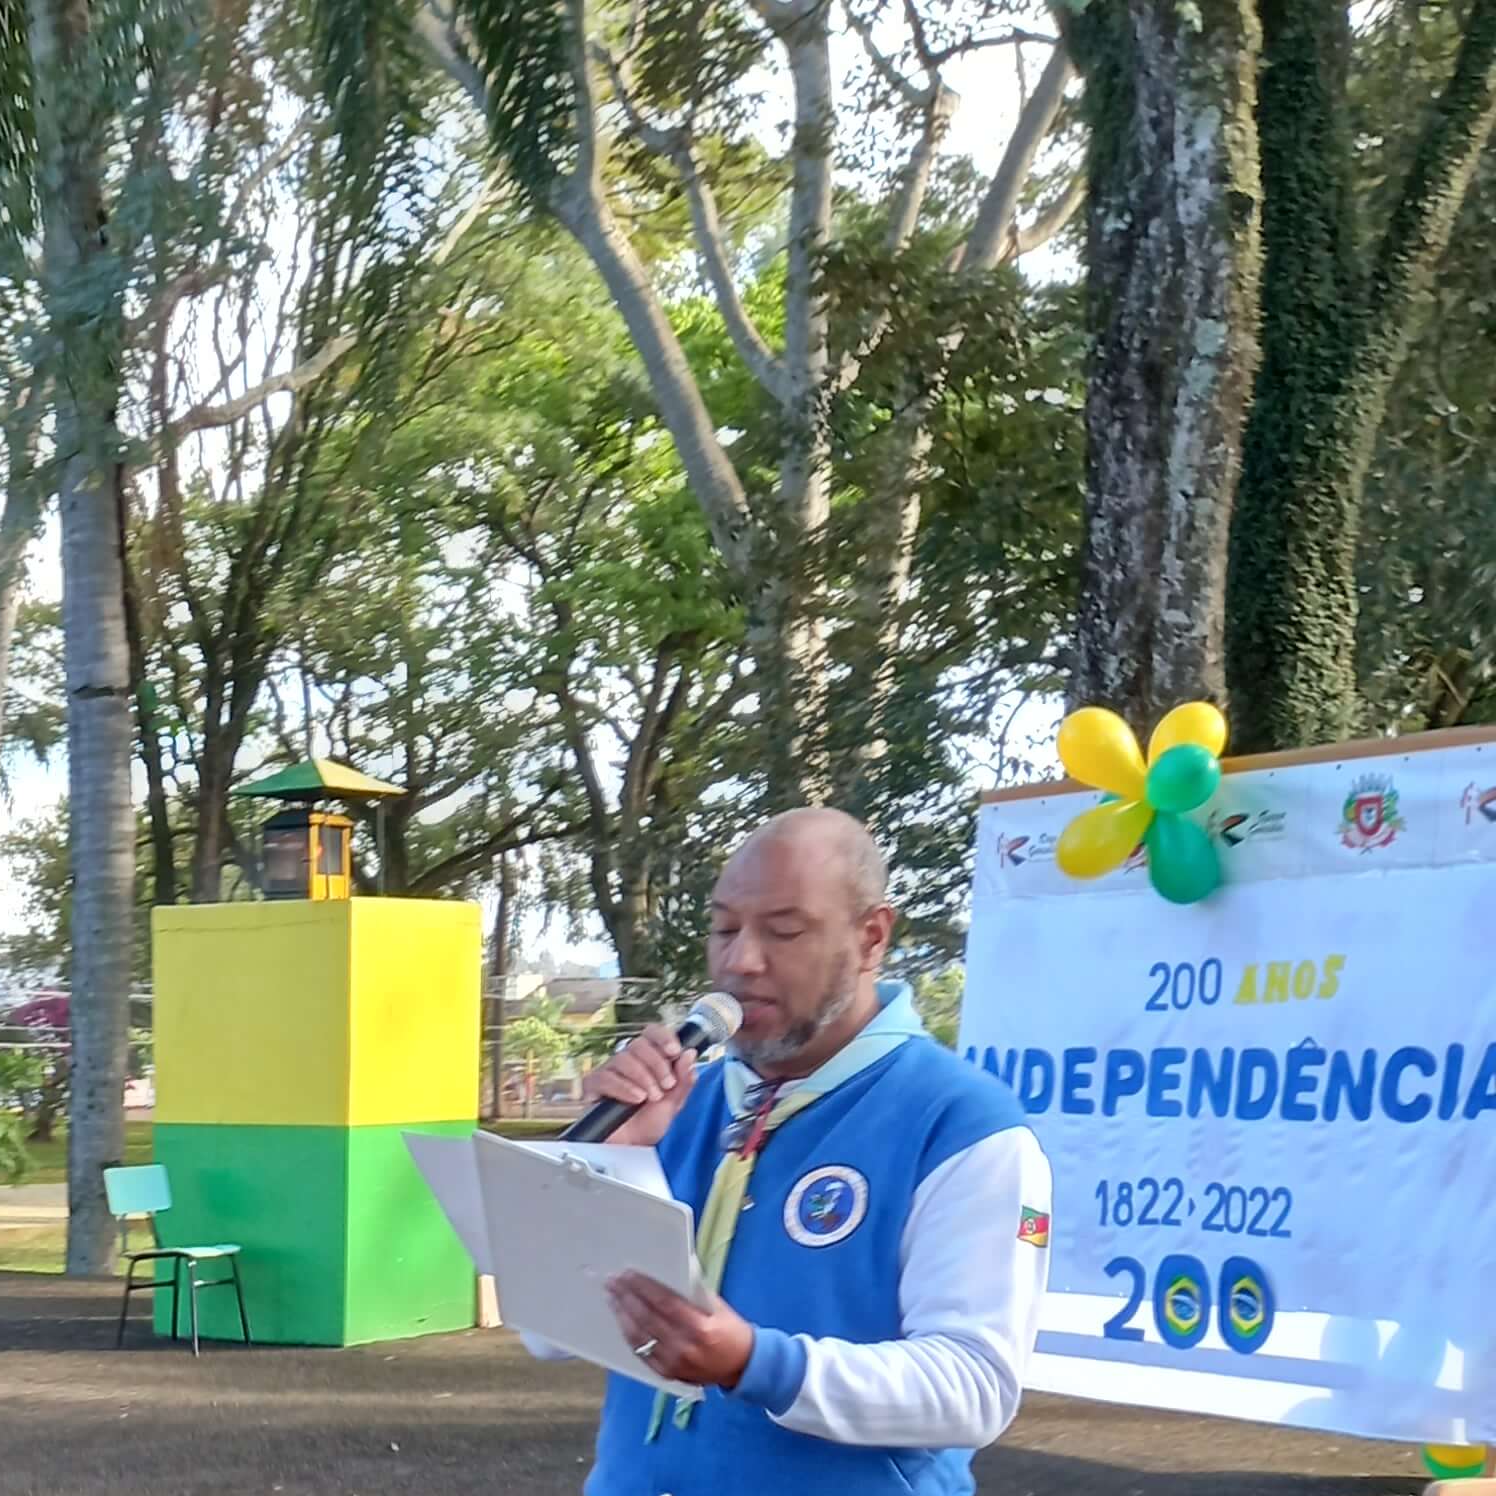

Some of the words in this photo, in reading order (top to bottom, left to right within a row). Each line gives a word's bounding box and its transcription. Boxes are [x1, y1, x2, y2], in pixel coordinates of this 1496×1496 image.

[1145, 957, 1223, 1011] 200
[964, 1036, 1496, 1124] NDEPENDÊNCIA
[1103, 1254, 1276, 1356] 200
